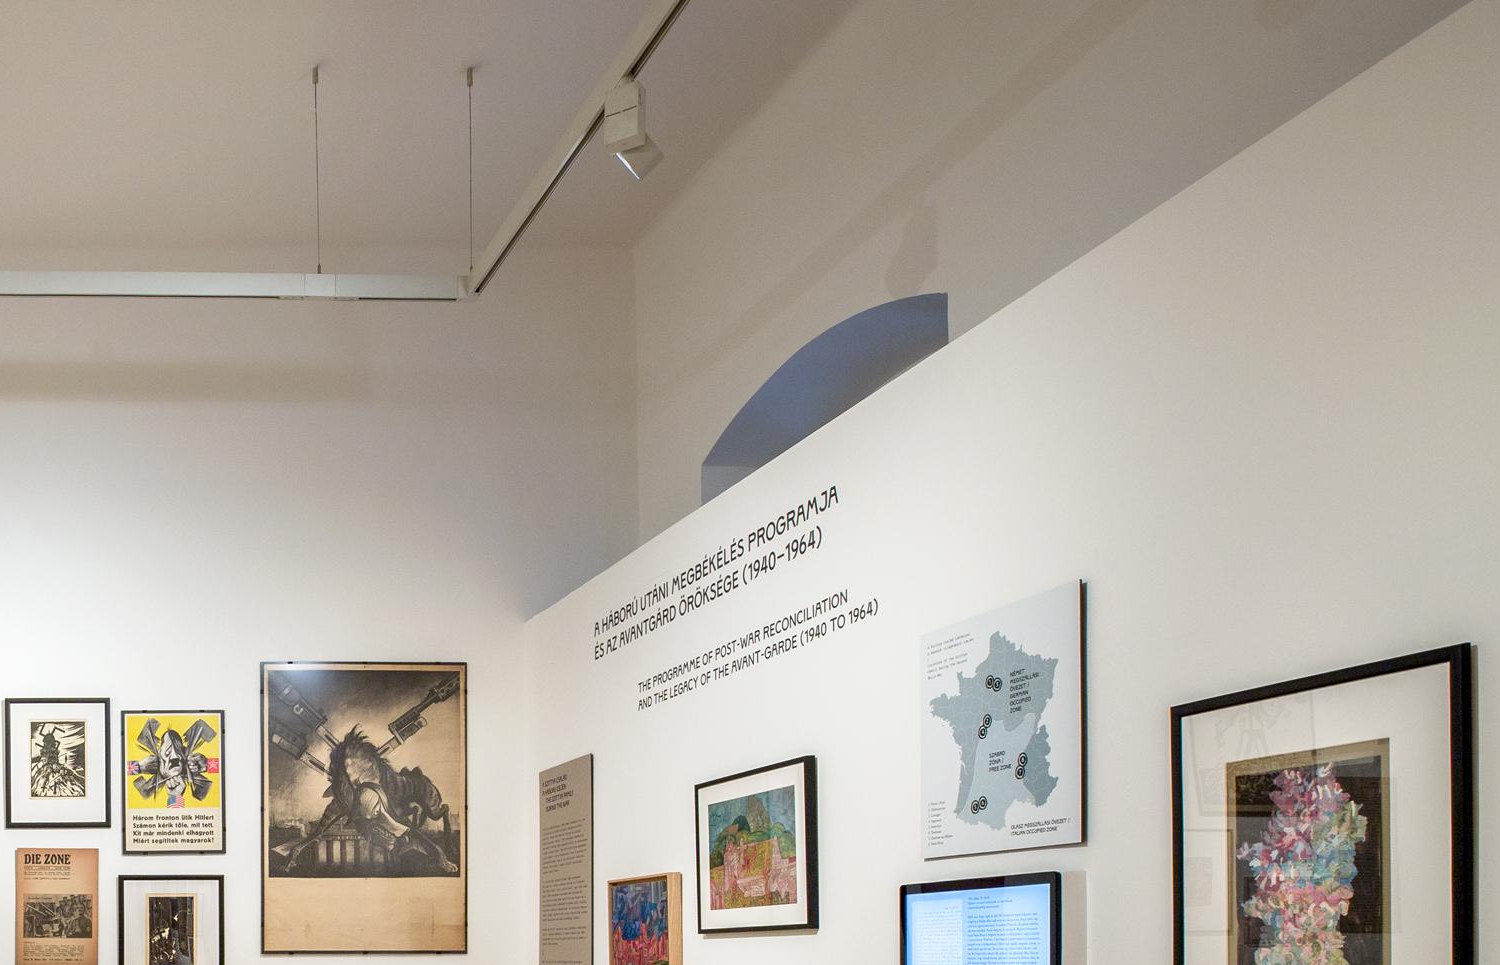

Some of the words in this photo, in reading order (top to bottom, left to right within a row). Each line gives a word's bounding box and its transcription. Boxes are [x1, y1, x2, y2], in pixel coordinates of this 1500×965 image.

[594, 621, 601, 637] A
[602, 597, 638, 633] HÁBORÚ
[640, 581, 669, 611] UTÁNI
[671, 537, 744, 594] MEGBÉKÉLÉS
[748, 485, 839, 552] PROGRAMJA
[594, 641, 605, 660] ÉS
[606, 634, 618, 655] AZ
[619, 604, 677, 648] AVANTGÁRD
[679, 570, 739, 616] ÖRÖKSÉGE
[638, 678, 651, 693] THE
[653, 656, 700, 688] PROGRAMME
[702, 650, 713, 666] OF
[715, 630, 760, 661] POST-WAR
[763, 589, 848, 638] RECONCILIATION
[638, 695, 653, 711] AND
[654, 689, 668, 705] THE
[669, 677, 698, 699] LEGACY
[700, 671, 711, 687] OF
[713, 664, 729, 681] THE
[731, 635, 798, 674] AVANT-GARDE
[800, 622, 827, 647] (1940
[830, 614, 845, 633] TO
[849, 598, 879, 625] 1964)
[24, 853, 42, 865] DIE
[44, 853, 71, 865] ZONE
[186, 829, 214, 837] elhagyott
